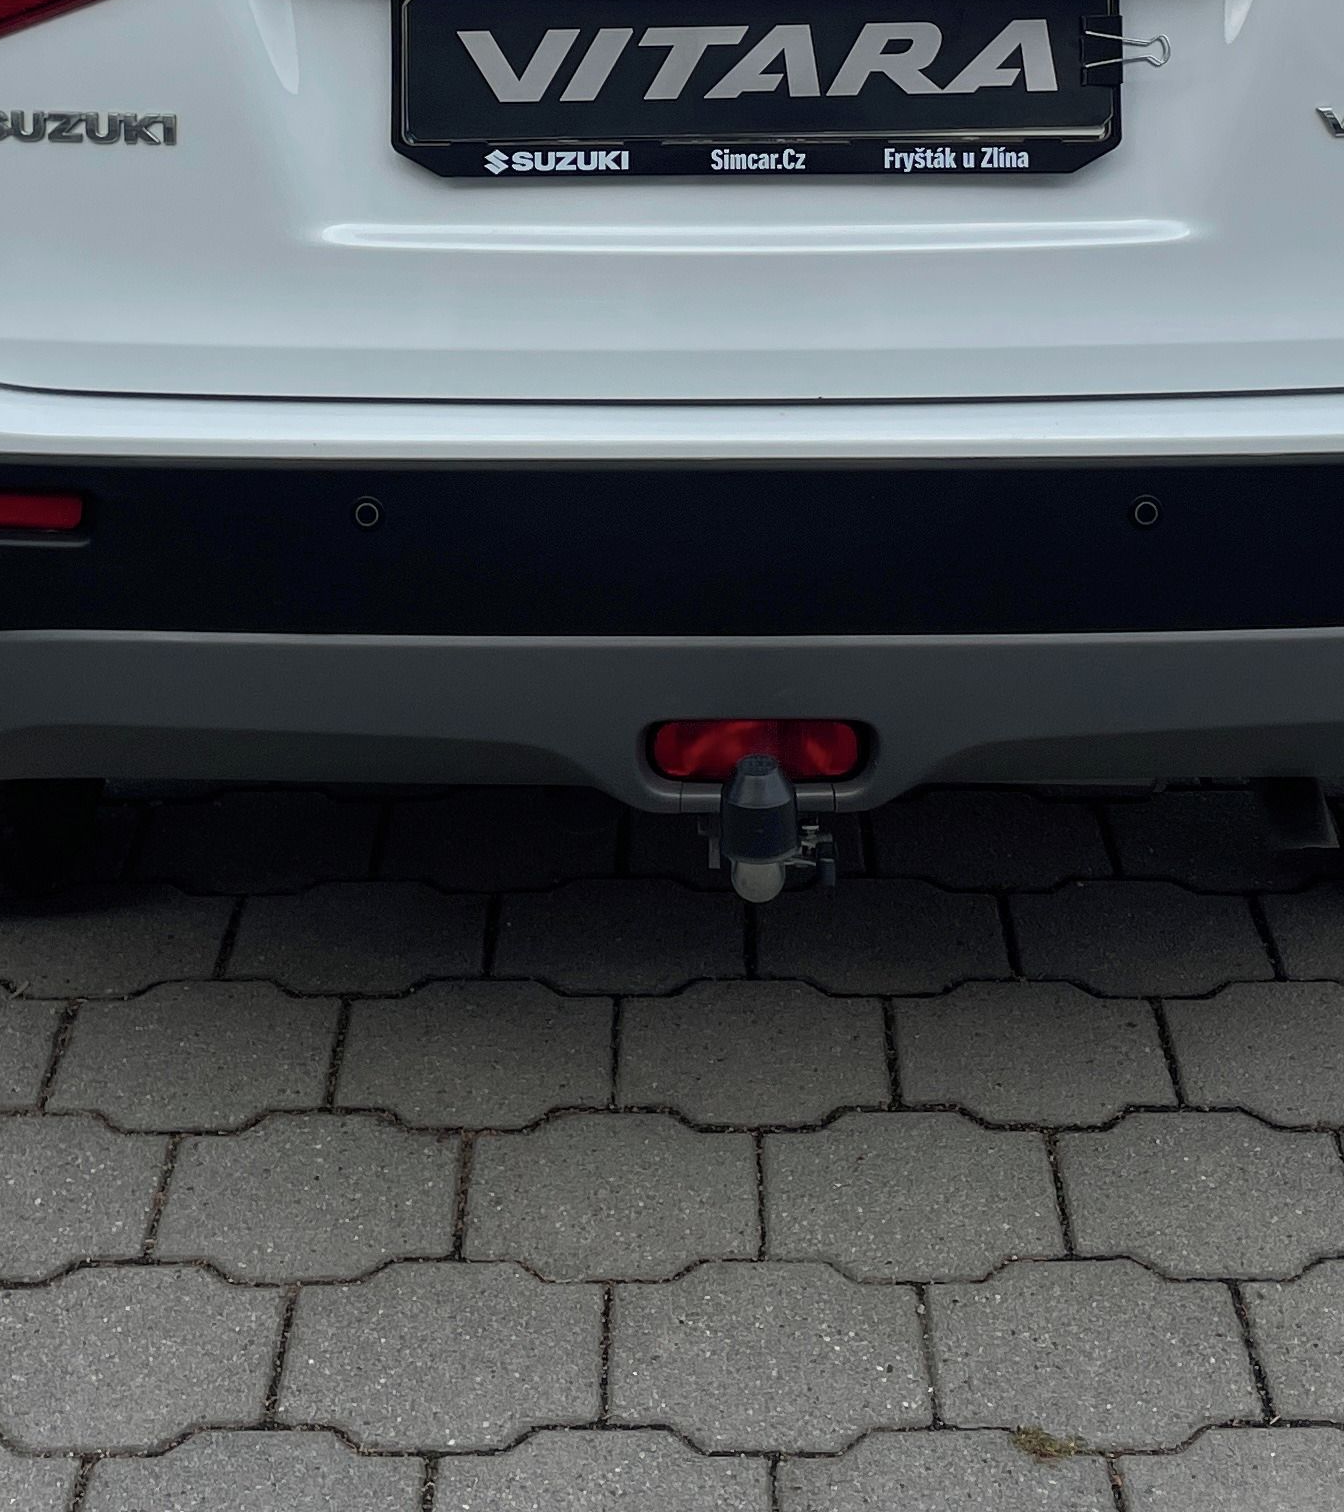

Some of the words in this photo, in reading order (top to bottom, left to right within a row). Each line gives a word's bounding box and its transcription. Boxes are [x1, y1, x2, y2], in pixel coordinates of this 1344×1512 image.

[456, 19, 1058, 103] VITARA
[511, 149, 630, 172] SUZUKI
[710, 148, 806, 170] Simcar.Cz
[883, 147, 957, 173] Fryšták
[962, 152, 975, 169] u
[980, 146, 1030, 169] Zlína
